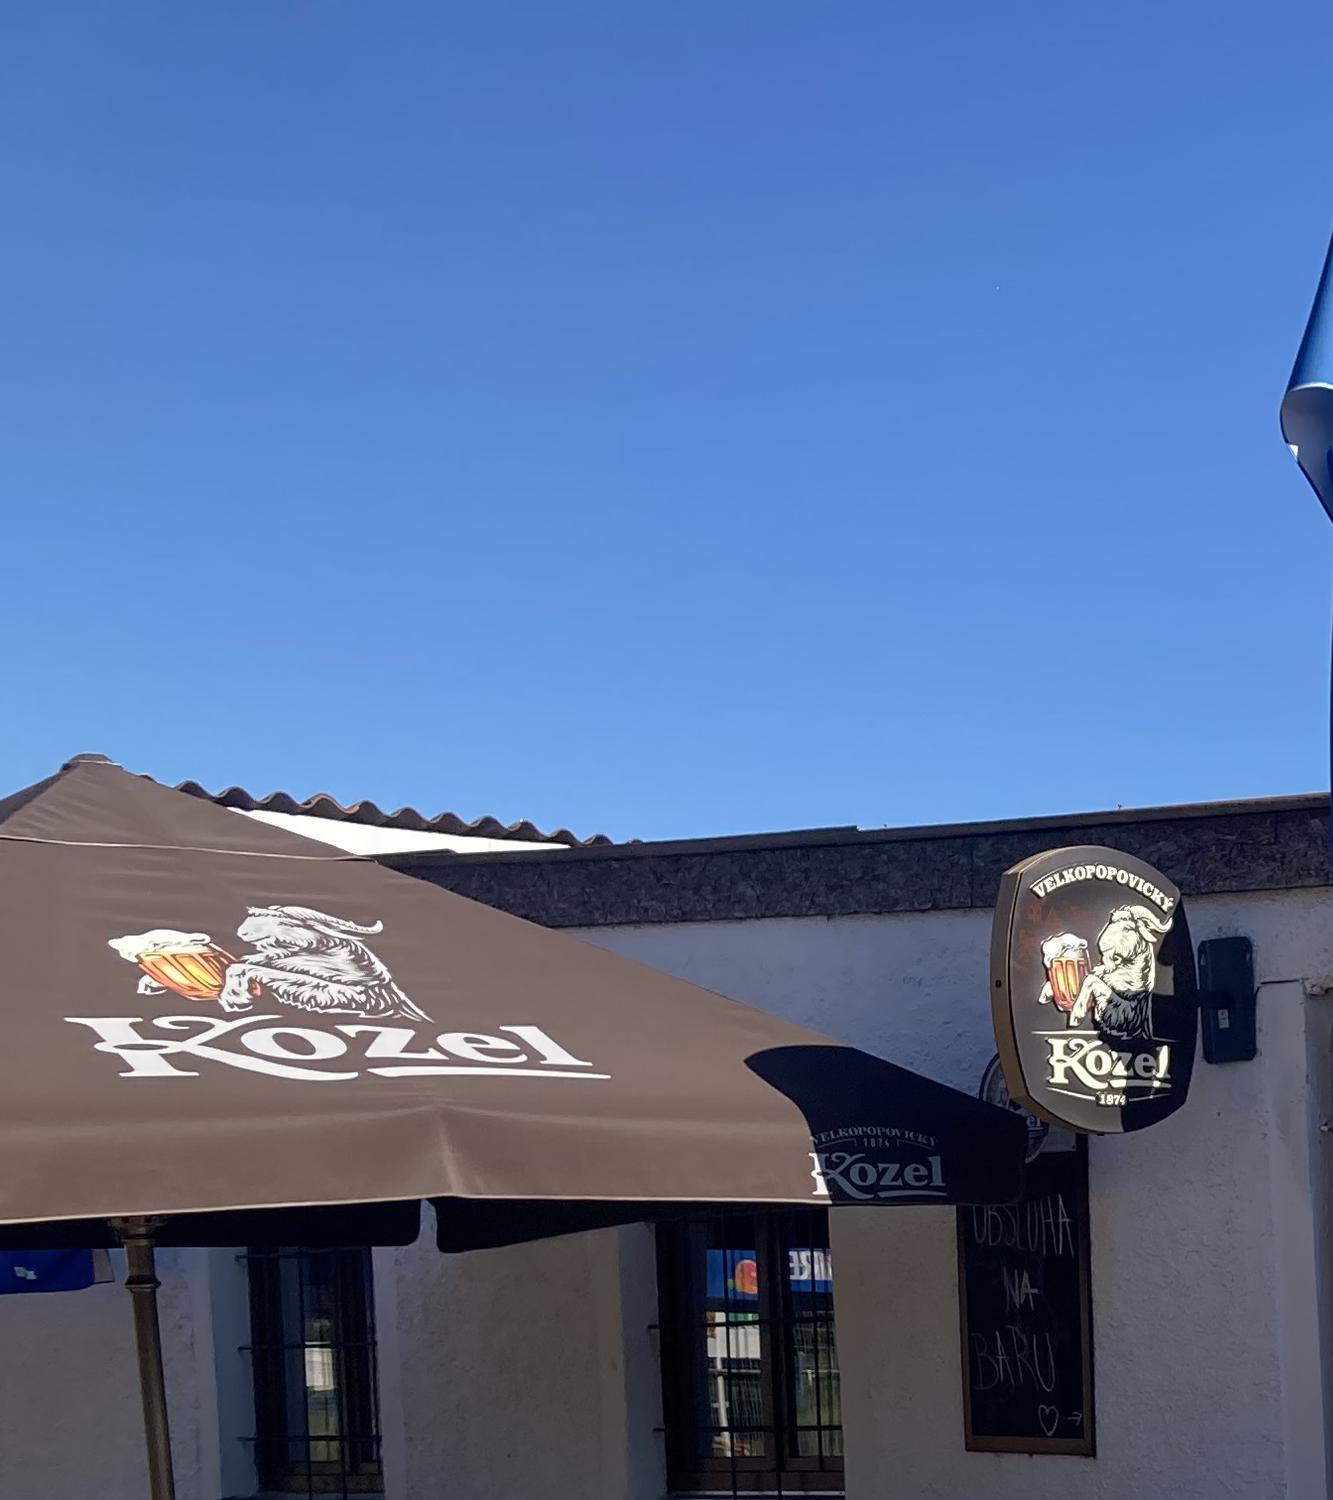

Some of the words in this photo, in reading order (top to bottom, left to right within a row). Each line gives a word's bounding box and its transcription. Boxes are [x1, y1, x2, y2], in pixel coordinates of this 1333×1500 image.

[1032, 864, 1175, 914] VELKOPOPOVICKÝ
[64, 1014, 611, 1081] Kozel
[1046, 1037, 1172, 1090] Kozel
[1098, 1094, 1127, 1106] 1874
[808, 1151, 949, 1200] Kozel
[971, 1193, 1076, 1258] OBSLUHA
[1003, 1267, 1041, 1313] NA
[971, 1324, 1056, 1393] BARU
